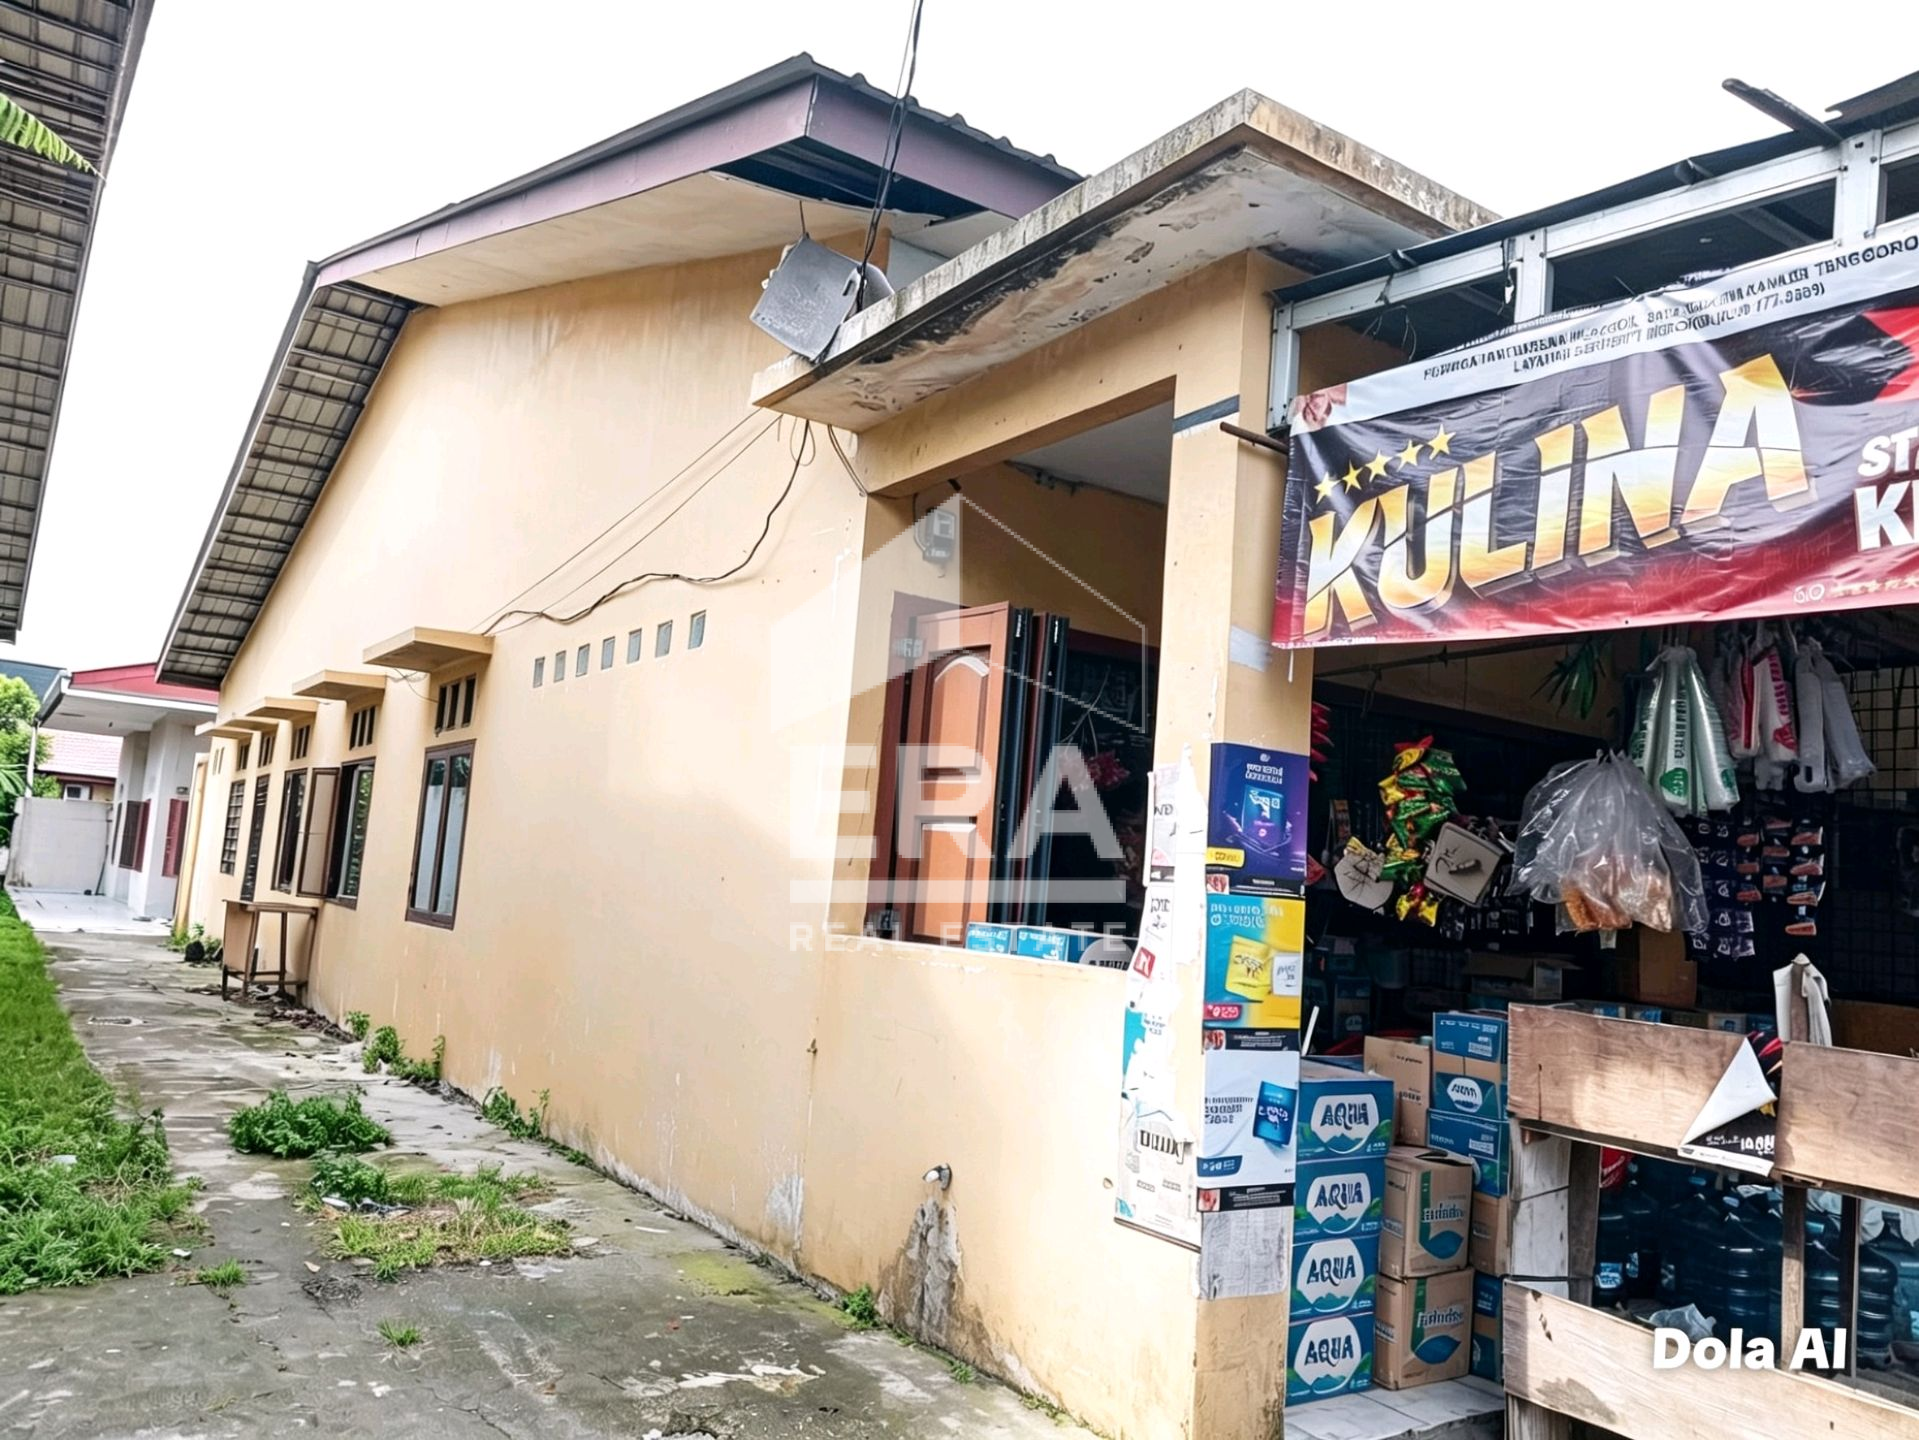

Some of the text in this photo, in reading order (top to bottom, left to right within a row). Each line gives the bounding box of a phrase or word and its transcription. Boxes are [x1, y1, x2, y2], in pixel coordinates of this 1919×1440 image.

[1857, 426, 1919, 477] ST
[1303, 353, 1810, 635] KULINA
[1306, 1255, 1356, 1286] AQUA
[1304, 1334, 1354, 1367] AQUA
